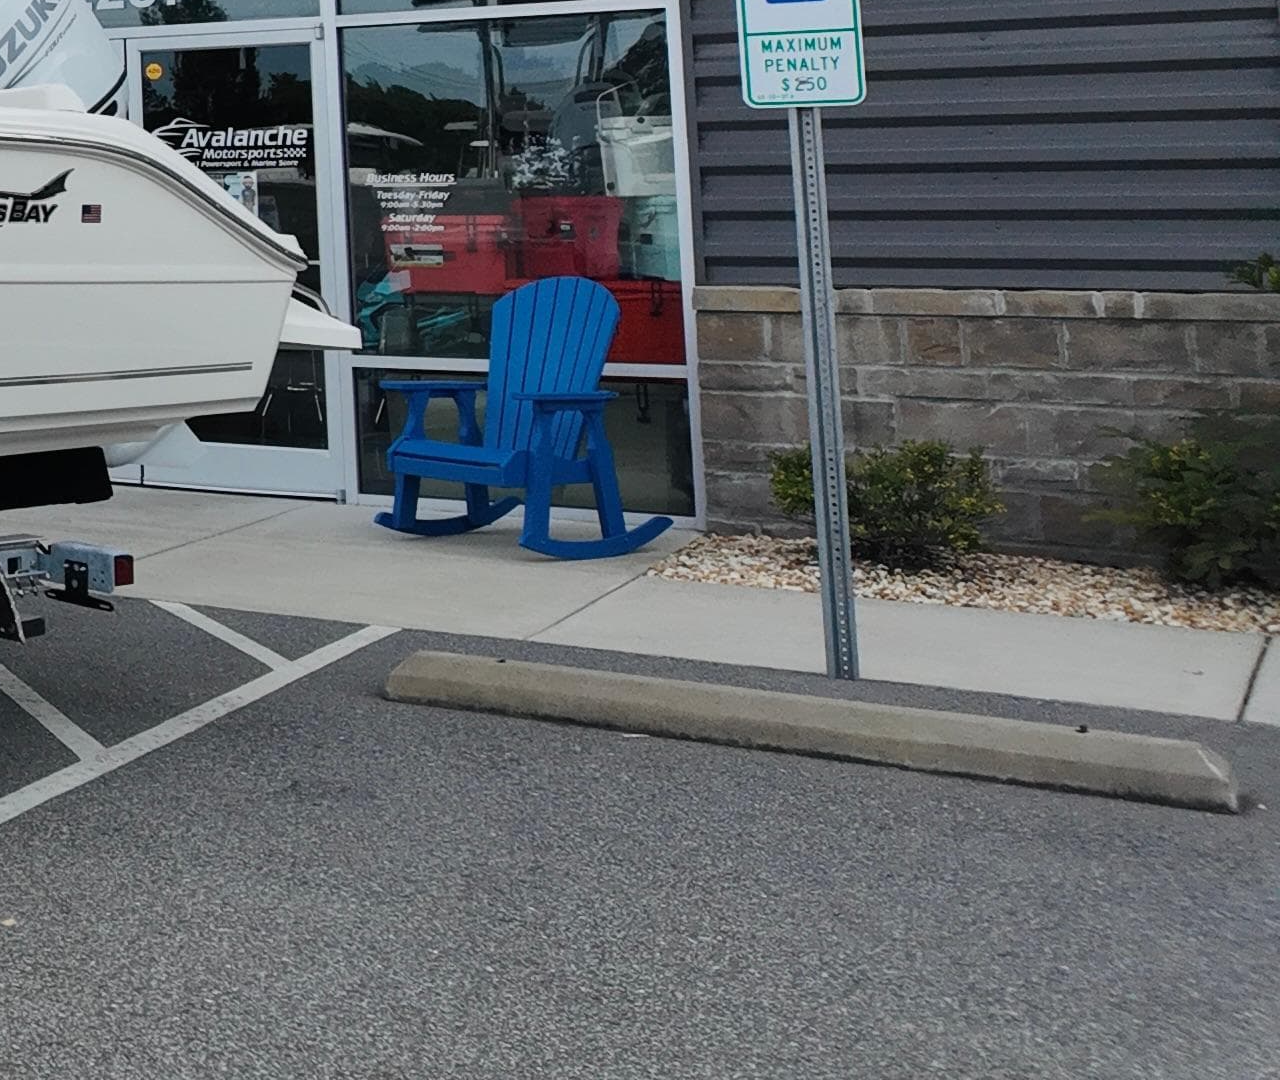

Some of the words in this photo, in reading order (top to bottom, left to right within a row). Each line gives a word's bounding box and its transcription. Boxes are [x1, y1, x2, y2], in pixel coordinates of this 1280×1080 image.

[761, 36, 842, 53] MAXIMUM
[765, 56, 840, 72] PENALTY
[180, 126, 308, 148] Avalanche
[202, 147, 284, 160] Motorsports
[366, 173, 417, 183] Business
[420, 173, 455, 183] Hours
[388, 213, 436, 223] Saturday
